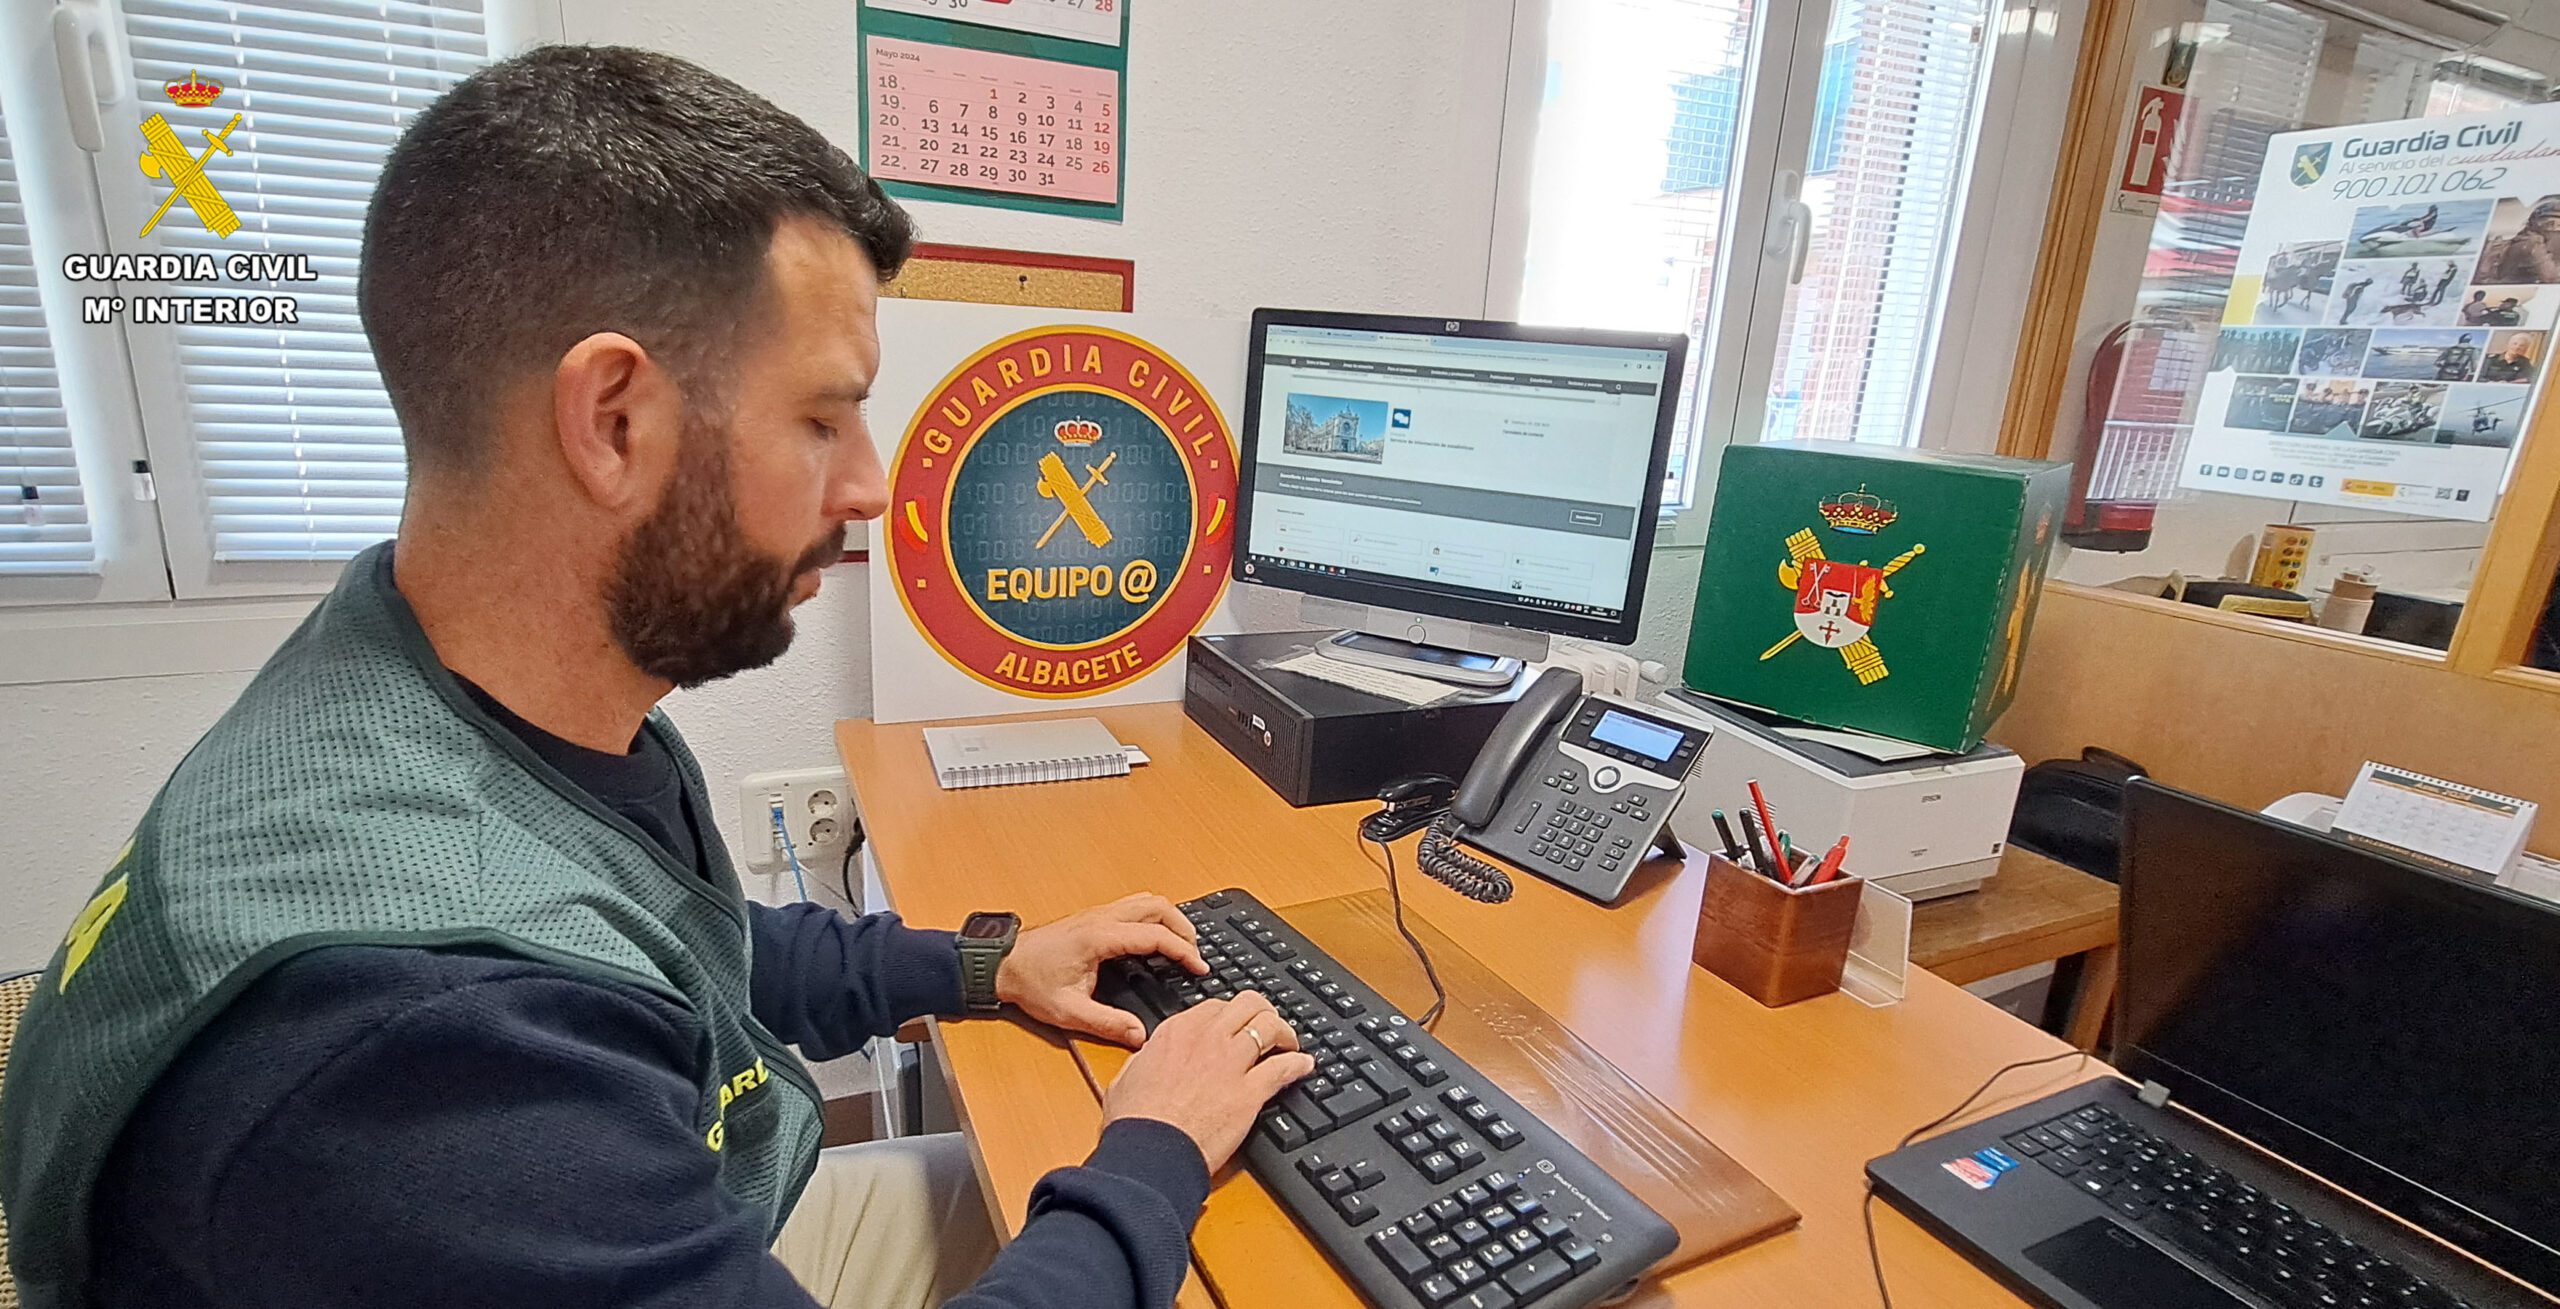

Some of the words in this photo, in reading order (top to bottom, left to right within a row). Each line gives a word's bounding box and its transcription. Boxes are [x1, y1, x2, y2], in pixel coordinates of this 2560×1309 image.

[876, 48, 898, 59] Mayo
[900, 52, 920, 62] 2024
[929, 99, 939, 114] 6
[959, 103, 969, 117] 7
[988, 105, 998, 119] 8
[1017, 112, 1027, 126] 9
[1037, 115, 1055, 127] 10
[1068, 119, 1083, 131] 11
[1094, 122, 1110, 134] 12
[990, 89, 998, 100] 1
[1018, 92, 1027, 104] 2
[1046, 96, 1055, 110] 3
[1074, 100, 1083, 114] 4
[1102, 103, 1111, 117] 5
[921, 118, 940, 133] 13
[951, 122, 969, 137] 14
[981, 126, 998, 141] 15
[1009, 131, 1027, 144] 16
[1039, 134, 1055, 147] 17
[1066, 138, 1083, 151] 18
[1094, 140, 1110, 155] 19
[2343, 130, 2450, 159] Guardia
[2457, 121, 2523, 148] Civil
[919, 139, 939, 152] 20
[951, 142, 969, 155] 21
[980, 146, 998, 159] 22
[1009, 149, 1027, 164] 23
[1037, 153, 1055, 168] 24
[1066, 156, 1083, 171] 25
[1092, 160, 1110, 174] 26
[920, 159, 940, 173] 27
[949, 163, 969, 177] 28
[979, 166, 998, 180] 29
[1008, 169, 1027, 183] 30
[1038, 172, 1055, 186] 31
[2339, 163, 2354, 175] Al
[2358, 158, 2416, 174] servicio
[2419, 154, 2444, 168] del
[2333, 177, 2388, 200] 900
[2387, 172, 2437, 196] 101
[2441, 167, 2508, 192] 062
[923, 344, 1102, 455] GUARDIA
[1128, 359, 1214, 456] CIVIL
[987, 564, 1113, 603] EQUIPO
[1119, 559, 1157, 603] @
[994, 641, 1143, 686] ALBACETE
[1553, 1173, 1572, 1189] Smart
[1571, 1187, 1586, 1200] Card
